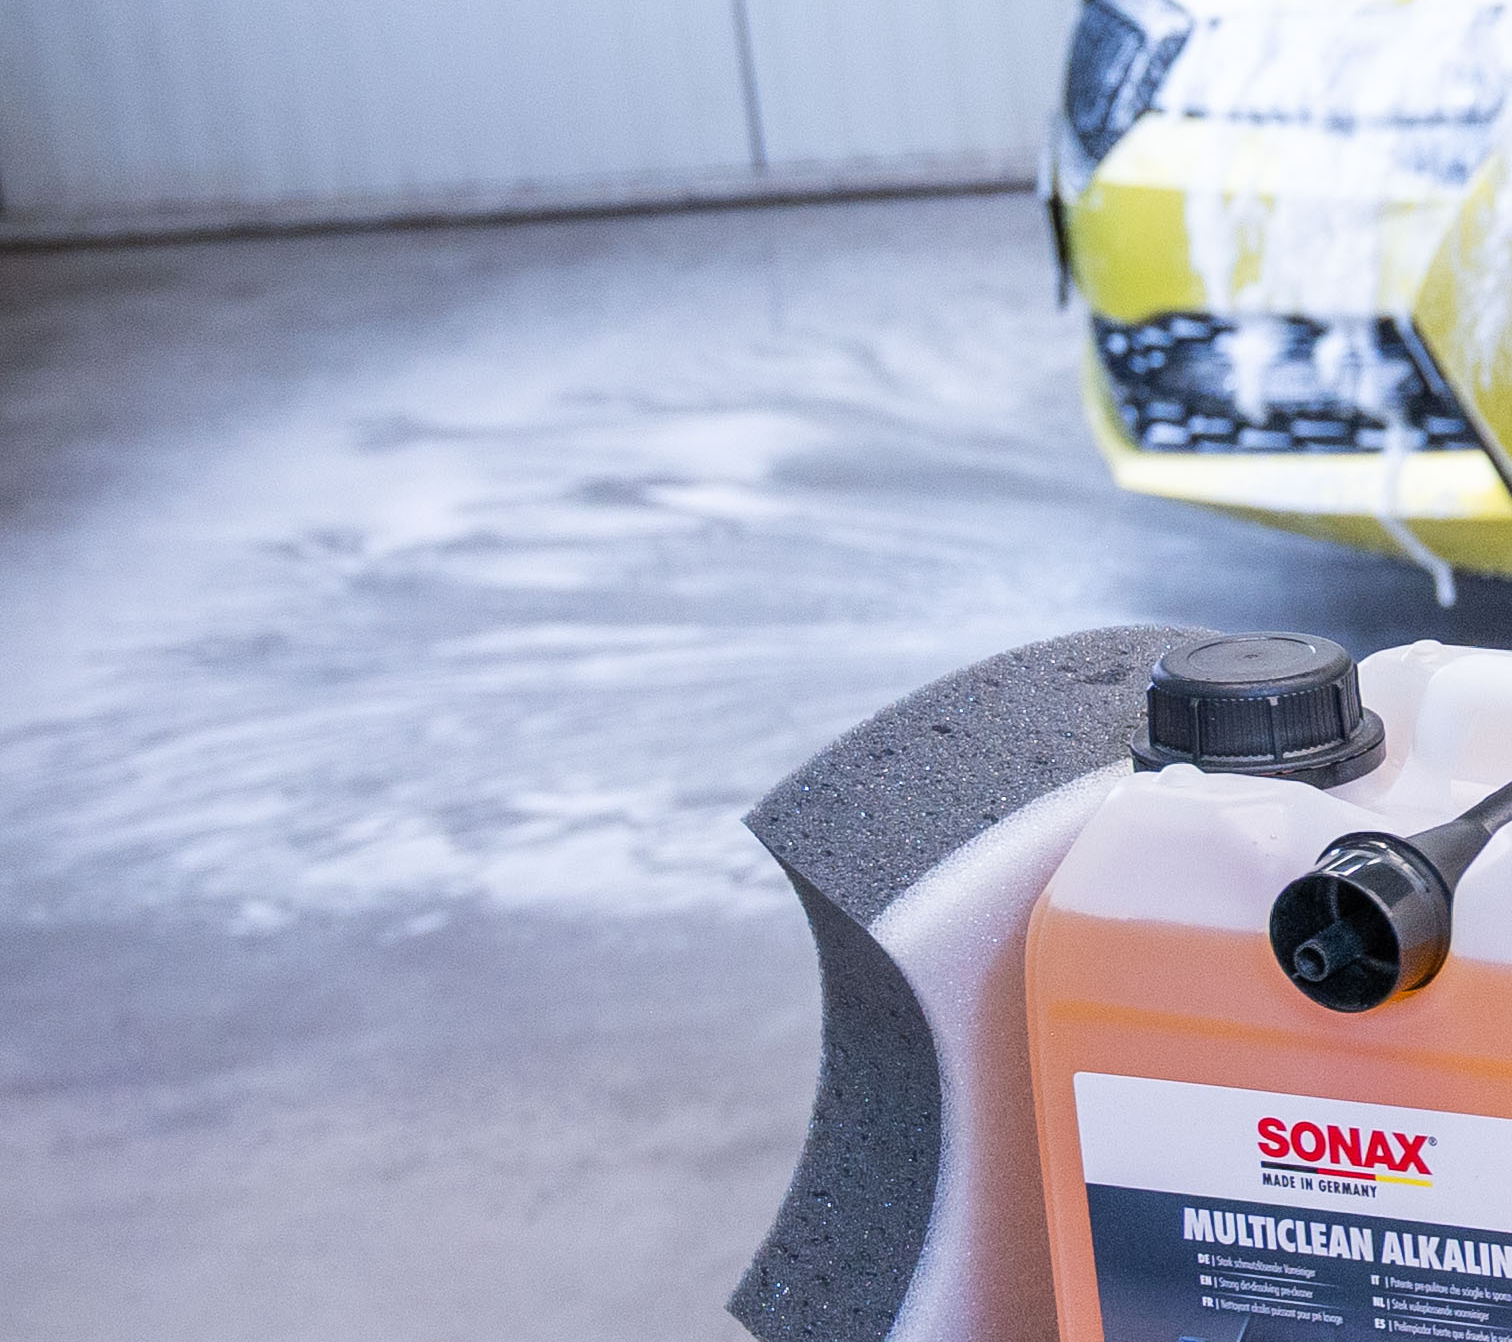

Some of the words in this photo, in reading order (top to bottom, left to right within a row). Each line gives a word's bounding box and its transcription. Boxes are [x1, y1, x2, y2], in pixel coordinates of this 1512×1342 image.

[1257, 1117, 1432, 1176] SONAX
[1262, 1173, 1296, 1191] MADE
[1301, 1176, 1313, 1192] IN
[1318, 1178, 1378, 1199] GERMANY
[1183, 1207, 1374, 1263] MULTICLEAN
